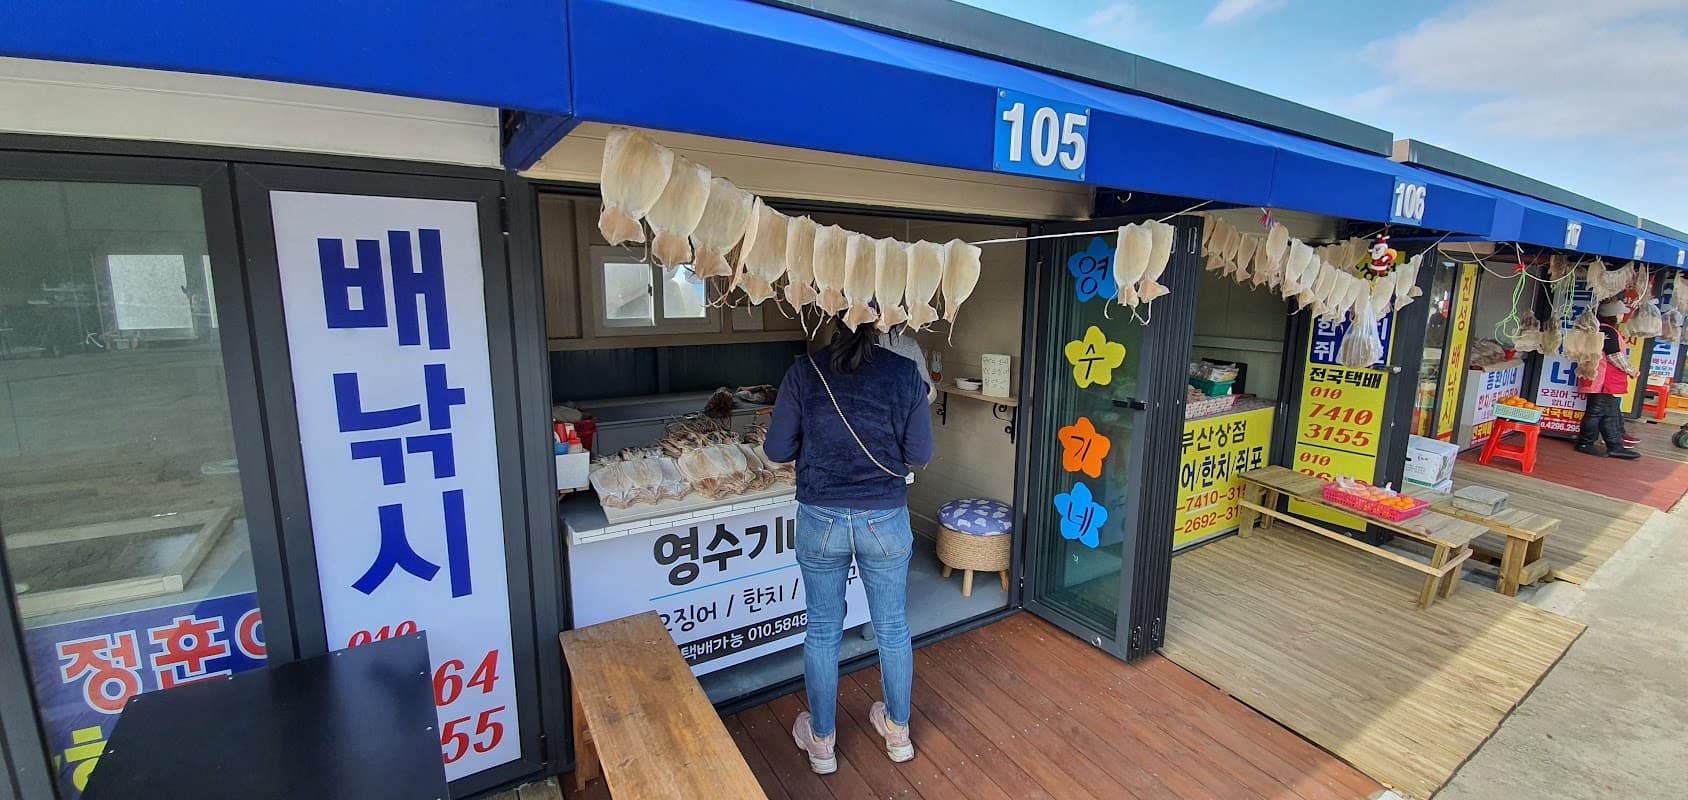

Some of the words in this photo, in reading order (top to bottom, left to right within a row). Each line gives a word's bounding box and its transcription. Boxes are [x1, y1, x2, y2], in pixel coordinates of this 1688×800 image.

[1003, 102, 1087, 170] 105
[1395, 182, 1427, 220] 106
[1078, 343, 1105, 380] 수
[1310, 367, 1383, 389] 전국택배
[1310, 386, 1342, 400] 010
[1442, 344, 1461, 424] 배낚시
[1541, 388, 1569, 399] 오징어
[317, 228, 473, 598] 배낚시
[1309, 402, 1374, 426] 7410
[1070, 435, 1092, 462] 기
[1182, 420, 1247, 455] 부산상점
[1303, 423, 1373, 447] 3155
[1299, 452, 1331, 466] 010
[1068, 501, 1095, 537] 네
[743, 585, 784, 613] 한치
[681, 631, 745, 661] 택배가능
[747, 611, 810, 642] 010.5848
